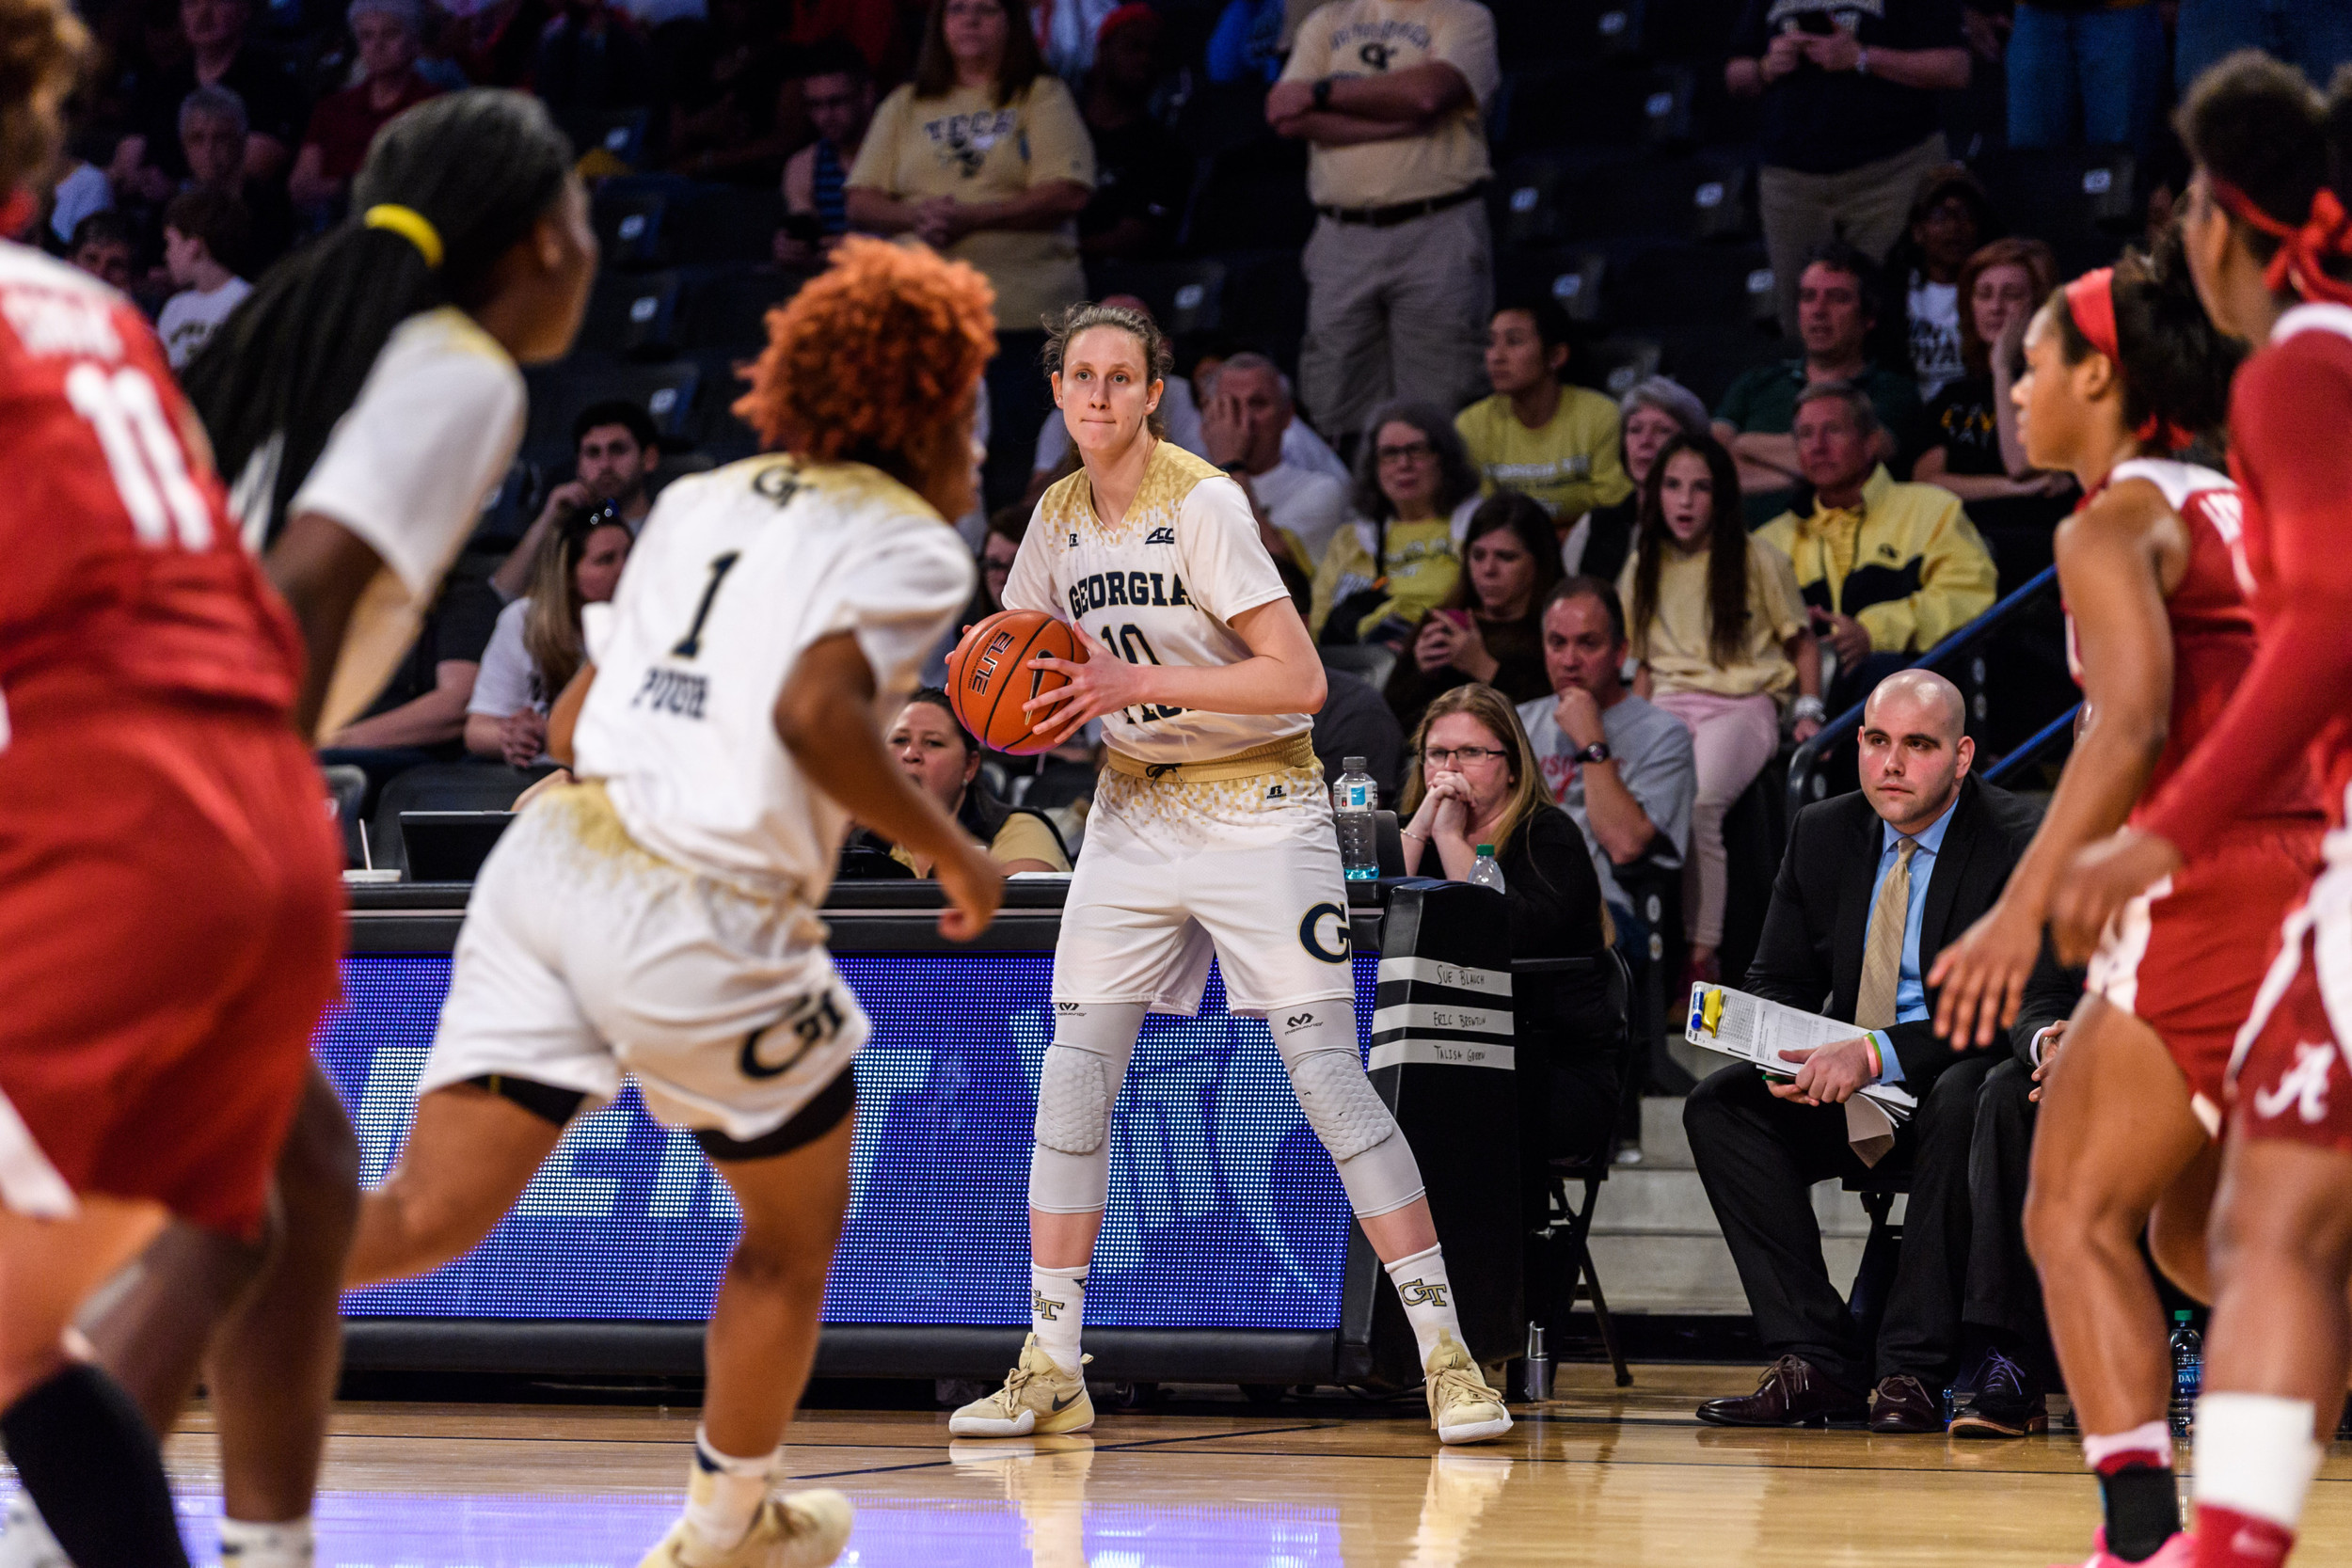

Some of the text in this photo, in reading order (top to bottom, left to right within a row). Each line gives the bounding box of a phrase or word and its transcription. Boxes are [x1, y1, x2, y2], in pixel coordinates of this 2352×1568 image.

[670, 548, 742, 662] 1
[1068, 570, 1198, 621] GEORGIA
[1437, 964, 1454, 985] SUE
[1433, 1011, 1454, 1027] ERIC
[1433, 1045, 1462, 1060] TALISA
[1399, 1277, 1448, 1307] GT
